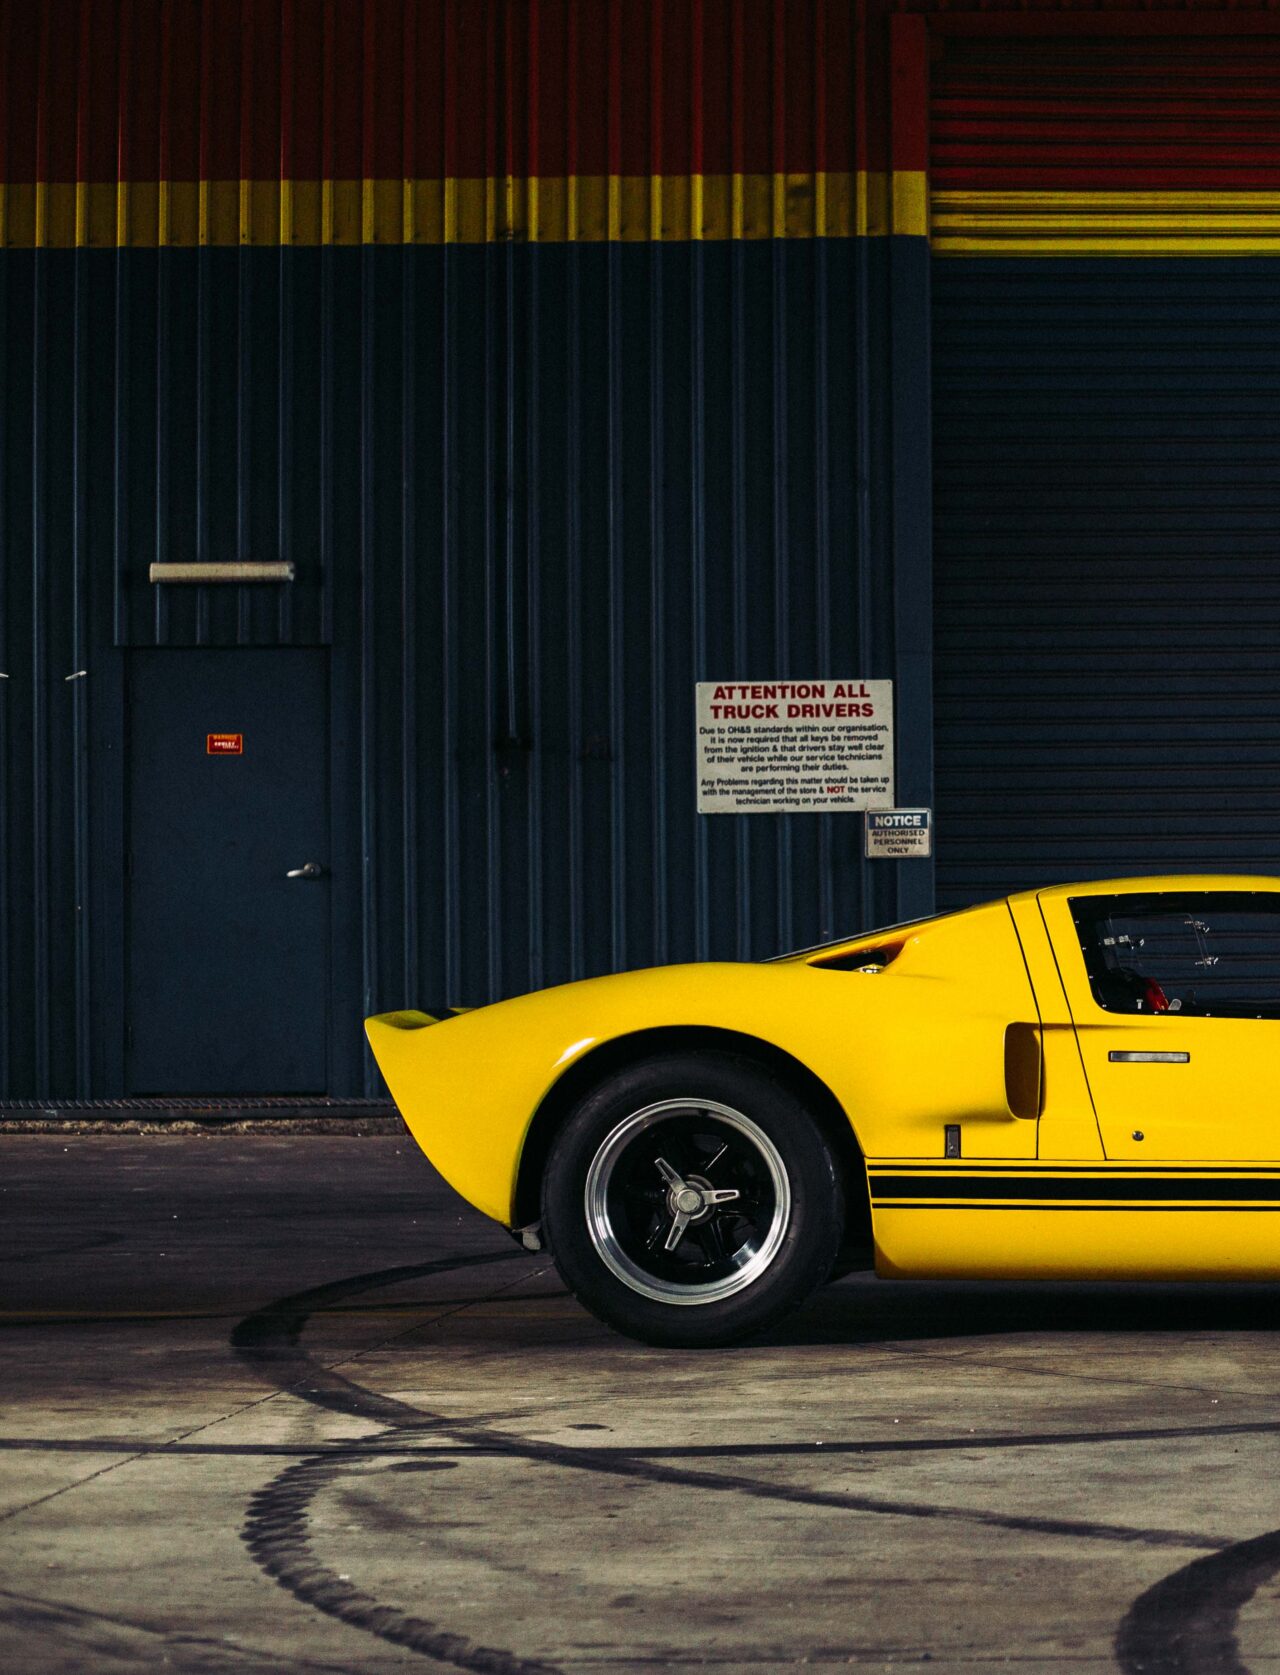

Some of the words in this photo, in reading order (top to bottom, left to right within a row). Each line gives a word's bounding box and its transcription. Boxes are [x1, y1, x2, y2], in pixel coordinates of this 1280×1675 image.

[713, 684, 825, 700] ATTENTION
[833, 684, 870, 698] ALL
[710, 704, 779, 719] TRUCK
[788, 703, 874, 718] DRIVERS
[699, 726, 715, 734] Due
[717, 726, 725, 734] to
[753, 724, 793, 733] standards
[795, 724, 819, 732] within
[718, 735, 725, 743] is
[746, 734, 779, 745] required
[781, 734, 797, 742] that
[799, 734, 808, 742] all
[810, 733, 828, 744] keys
[831, 733, 841, 741] be
[843, 732, 878, 741] removed
[704, 745, 722, 753] from
[724, 745, 737, 753] the
[740, 744, 769, 755] ignition
[772, 744, 778, 752] &
[780, 744, 796, 752] that
[798, 743, 826, 752] drivers
[828, 743, 845, 753] stay
[847, 742, 862, 751] well
[864, 742, 884, 751] clear
[706, 755, 715, 763] of
[716, 754, 735, 763] their
[736, 754, 765, 762] vehicle
[766, 753, 788, 762] while
[805, 753, 835, 761] service
[836, 752, 882, 761] technicians
[755, 763, 800, 774] performing
[802, 762, 820, 771] their
[701, 778, 714, 788] Any
[716, 777, 749, 786] Problems
[751, 777, 783, 787] regarding
[800, 776, 822, 784] matter
[824, 776, 847, 784] should
[860, 775, 878, 783] taken
[880, 777, 889, 785] up
[731, 786, 776, 797] management
[799, 786, 816, 794] store
[860, 785, 886, 793] service
[735, 796, 770, 805] technician
[772, 796, 800, 806] working
[812, 797, 828, 805] your
[875, 815, 921, 826] NOTICE
